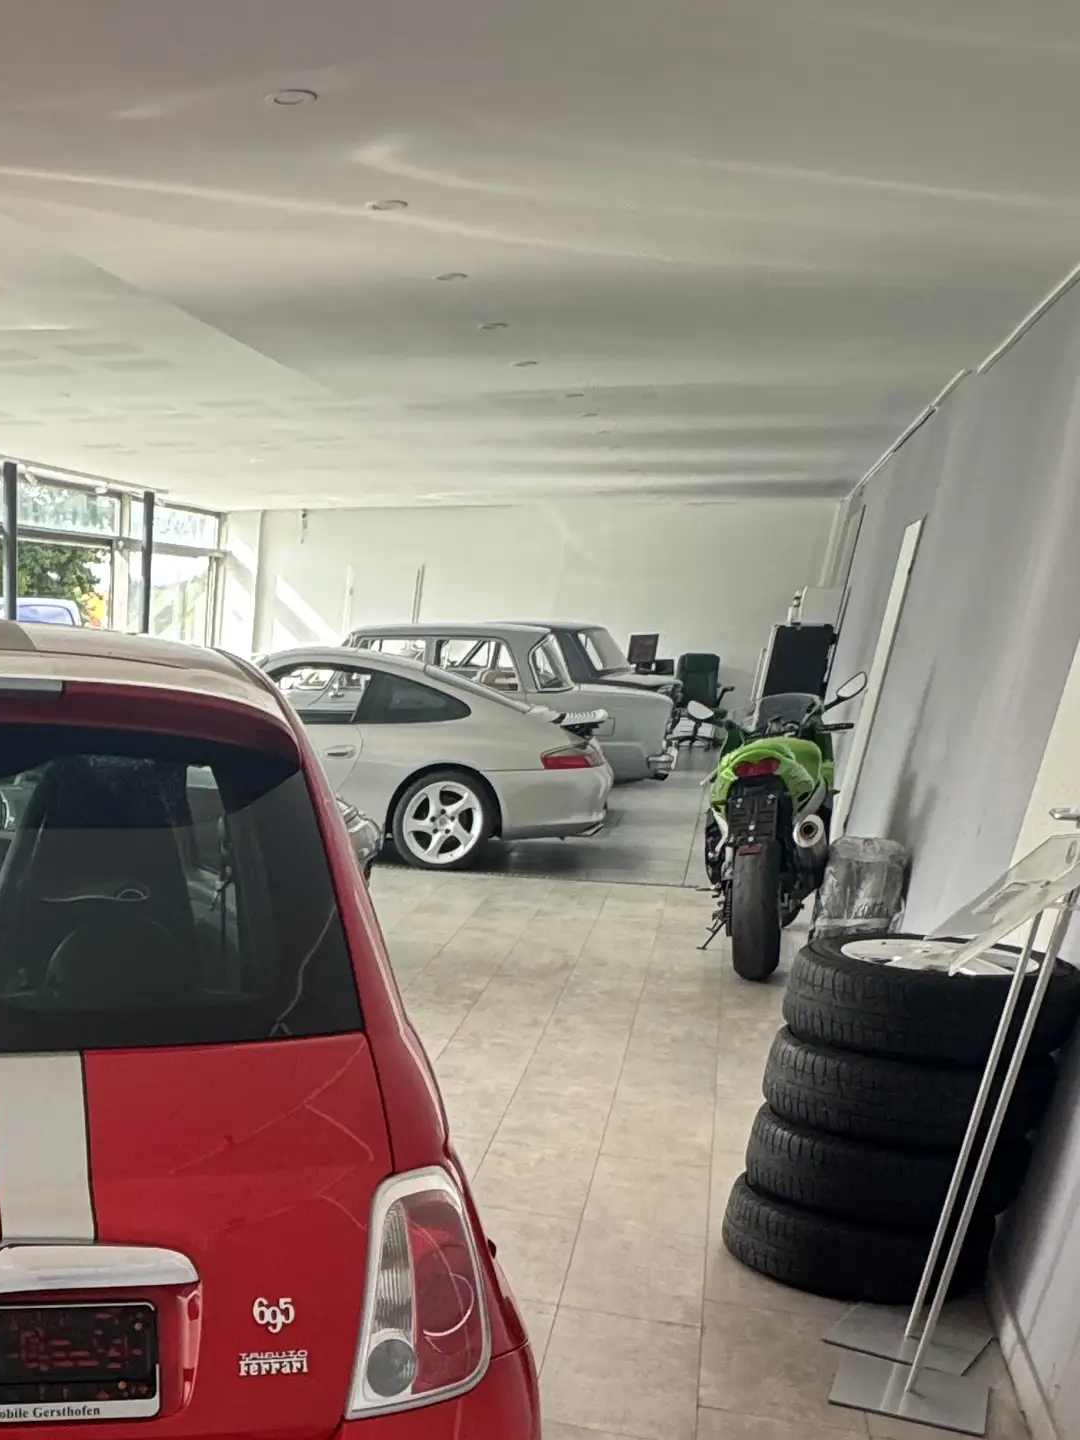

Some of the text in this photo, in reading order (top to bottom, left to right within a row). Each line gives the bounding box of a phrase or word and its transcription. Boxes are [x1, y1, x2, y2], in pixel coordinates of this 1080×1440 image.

[252, 1297, 295, 1333] 695
[239, 1357, 308, 1376] Ferrari
[32, 1405, 100, 1419] Gersthofen
